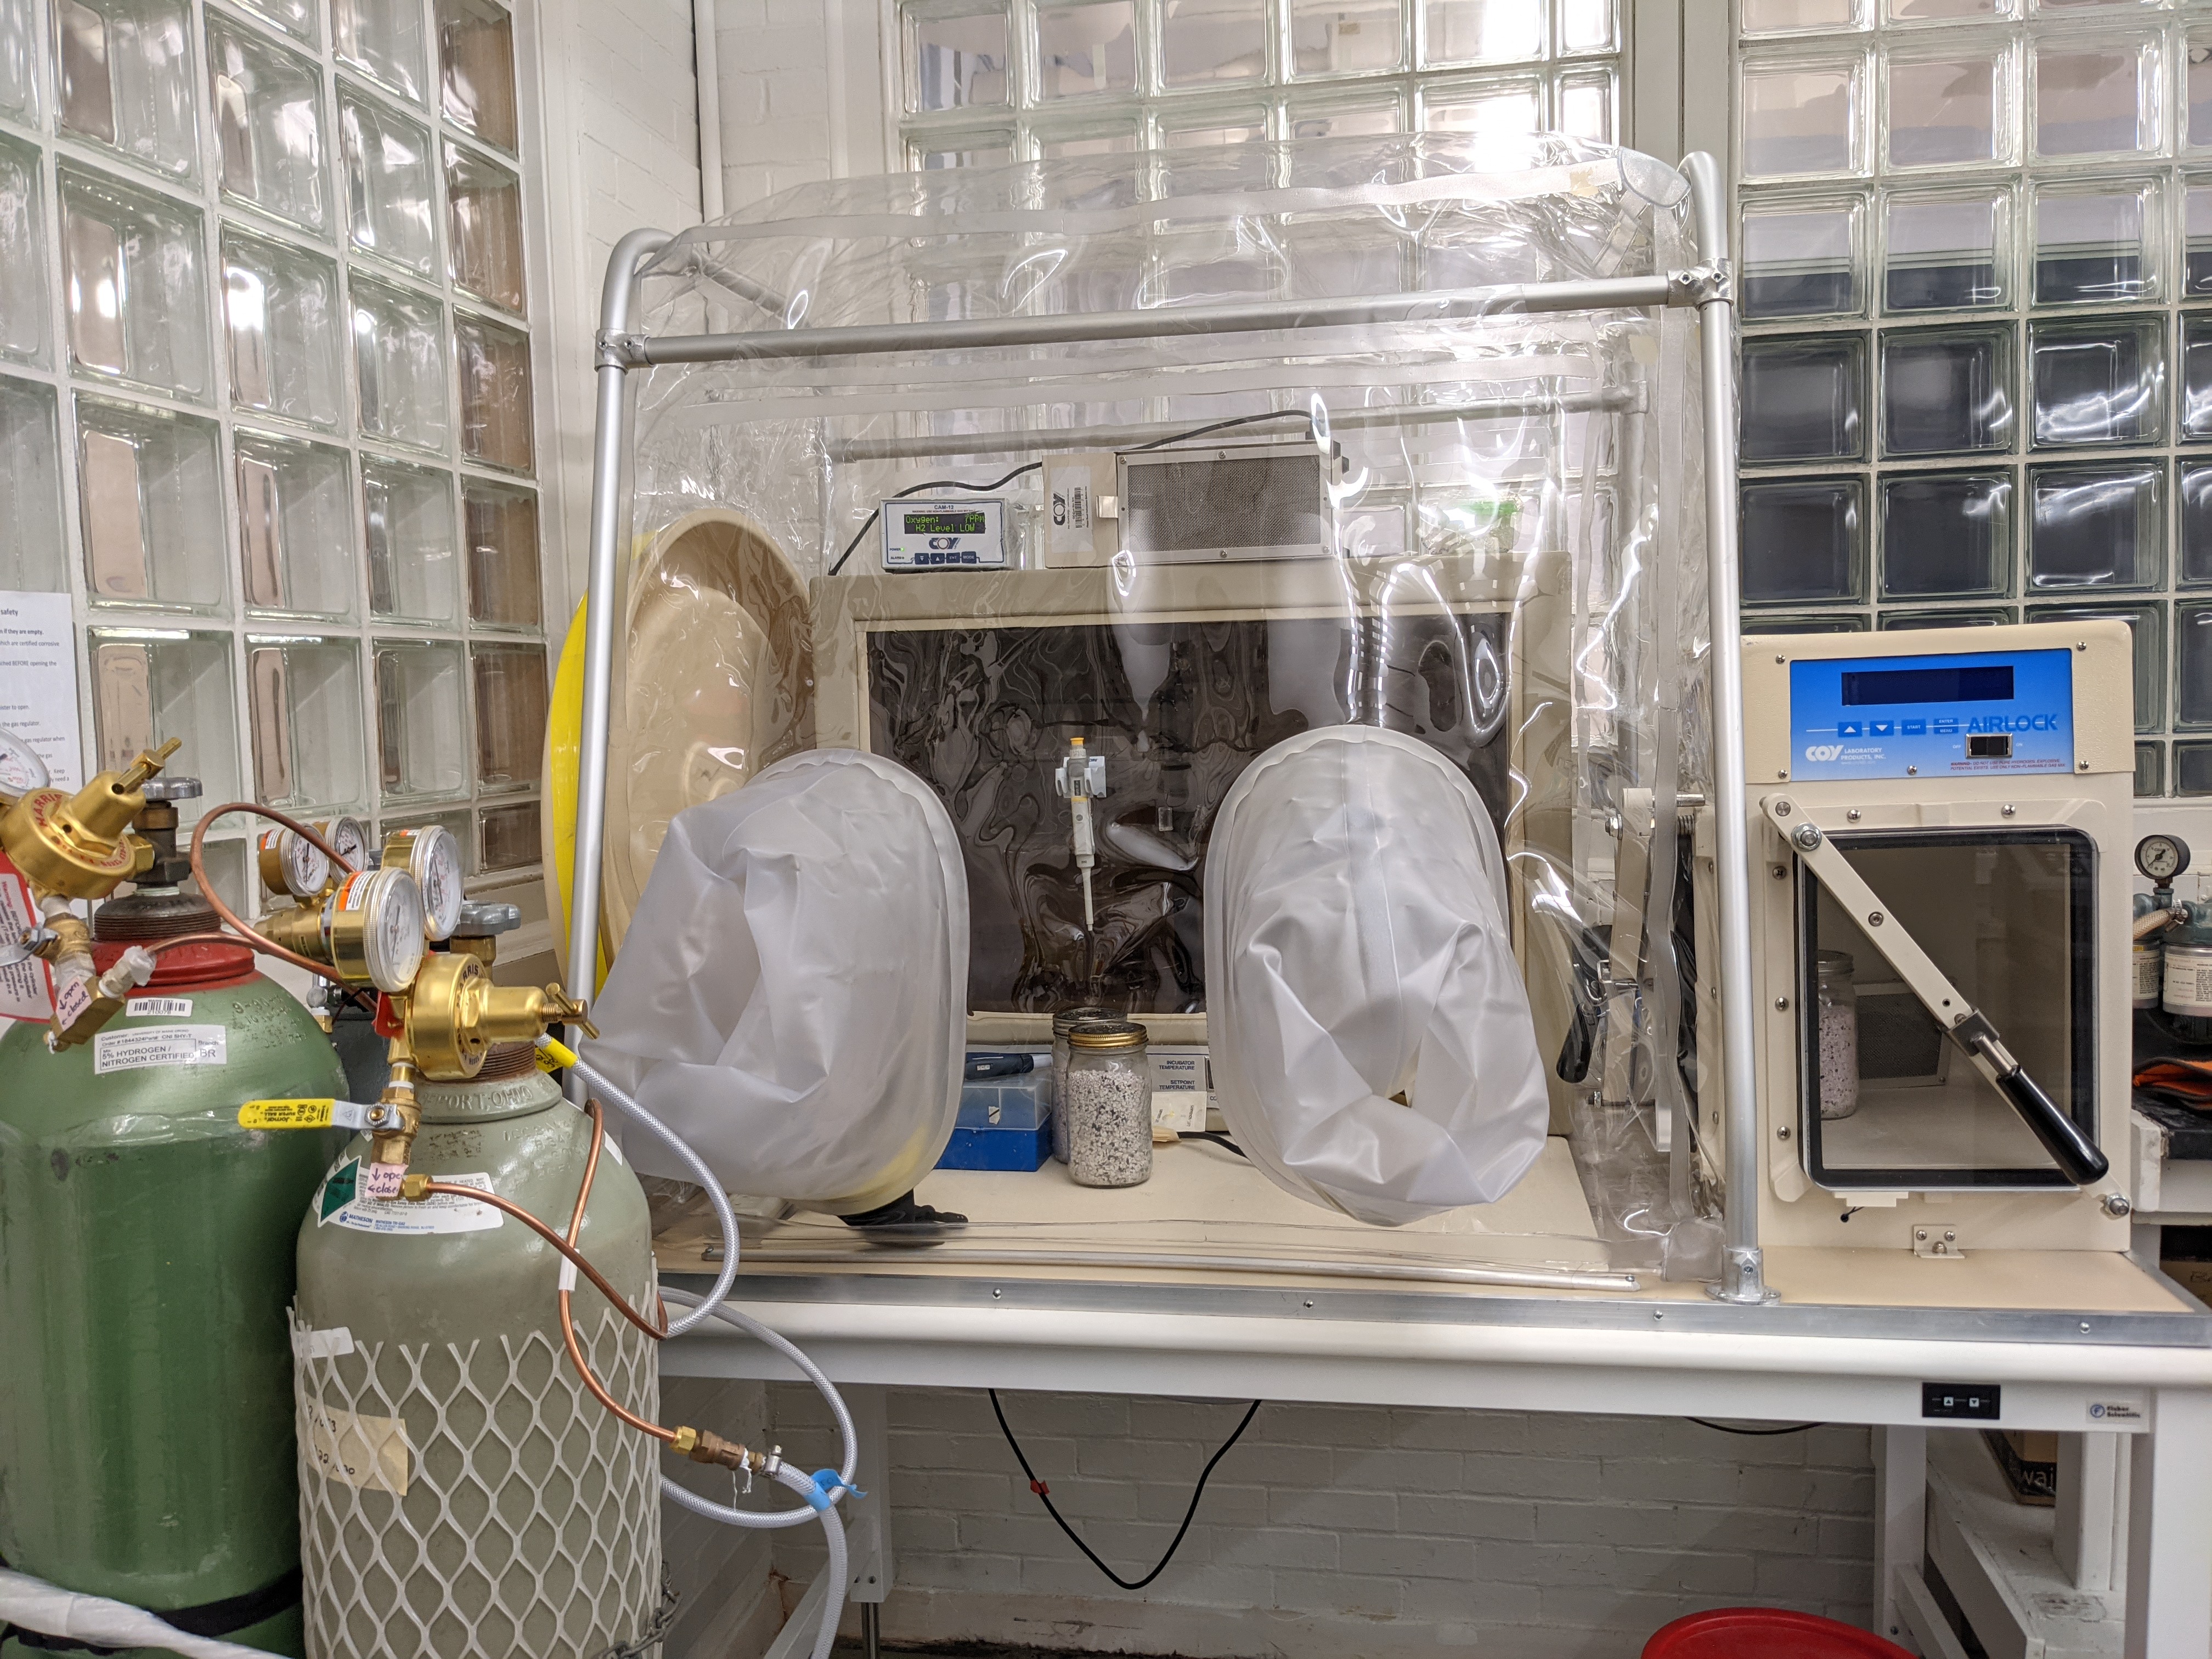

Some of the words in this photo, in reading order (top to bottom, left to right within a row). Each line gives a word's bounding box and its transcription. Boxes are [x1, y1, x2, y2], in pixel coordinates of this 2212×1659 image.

[1053, 493, 1066, 526] COY
[906, 516, 939, 524] Oxygen:
[916, 524, 926, 532] H2
[930, 523, 955, 532] Level
[960, 523, 975, 532] LOW
[928, 537, 960, 550] COY
[1, 608, 18, 617] safety
[1967, 714, 2058, 733] AIRLOCK
[1805, 744, 1844, 761] COY
[29, 972, 38, 995] cylinder
[64, 981, 80, 1000] open
[67, 990, 89, 1017] closed
[116, 1046, 167, 1057] HYDROGEN
[199, 1049, 216, 1058] BR
[101, 1056, 147, 1067] NITROGEN
[149, 1052, 195, 1061] CERTIFIED
[492, 1086, 533, 1108] OHIO
[383, 1172, 403, 1182] ope
[376, 1183, 399, 1194] close
[348, 1213, 374, 1224] MATHESON
